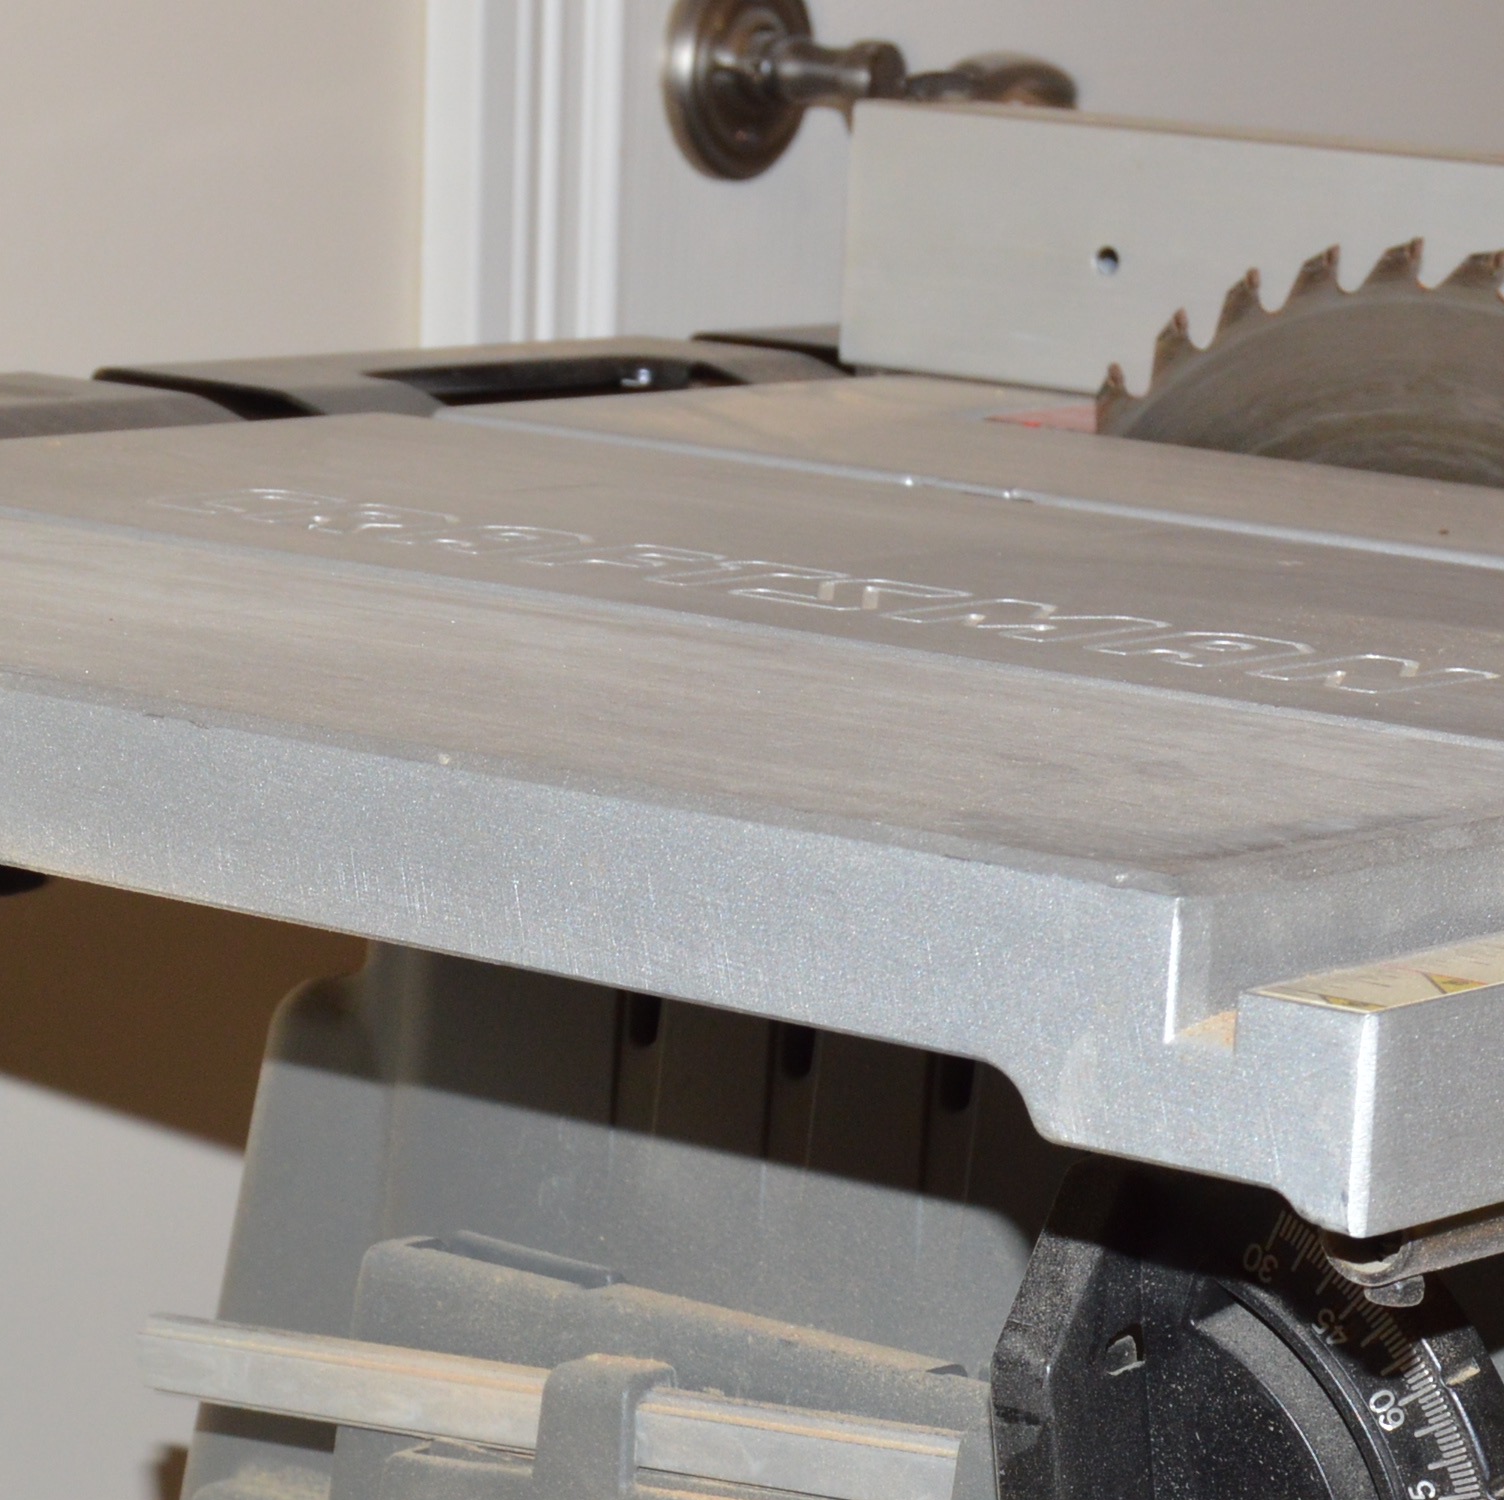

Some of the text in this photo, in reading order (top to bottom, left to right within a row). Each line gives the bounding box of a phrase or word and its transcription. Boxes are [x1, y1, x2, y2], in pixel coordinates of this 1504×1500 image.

[141, 487, 1500, 696] CRAFTSMAN
[1243, 1242, 1280, 1284] 30
[1311, 1307, 1347, 1346] 45
[1368, 1388, 1405, 1432] 60
